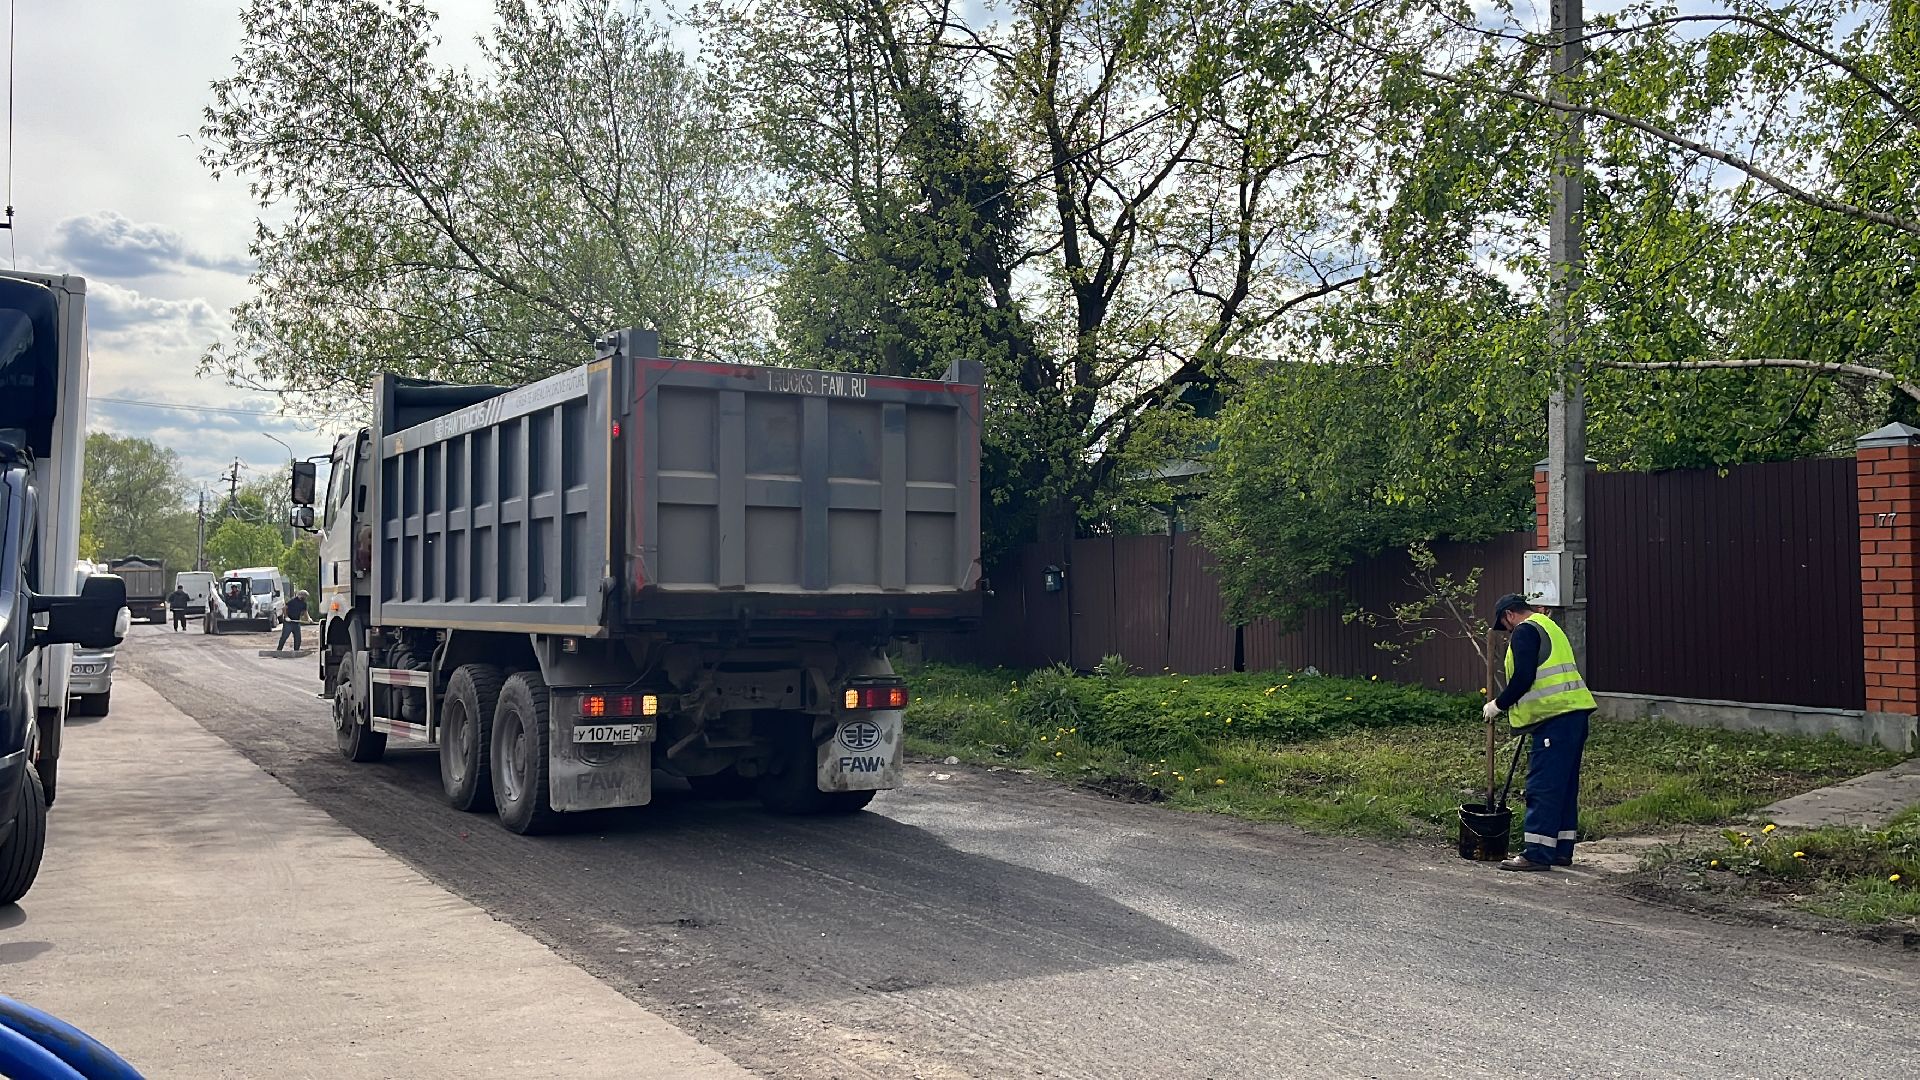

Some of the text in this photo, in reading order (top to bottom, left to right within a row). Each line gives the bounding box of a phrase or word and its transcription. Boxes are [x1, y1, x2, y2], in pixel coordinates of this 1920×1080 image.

[458, 407, 485, 432] TRUCKS
[1878, 513, 1897, 527] 77
[632, 725, 653, 737] 797
[840, 756, 881, 773] FAW
